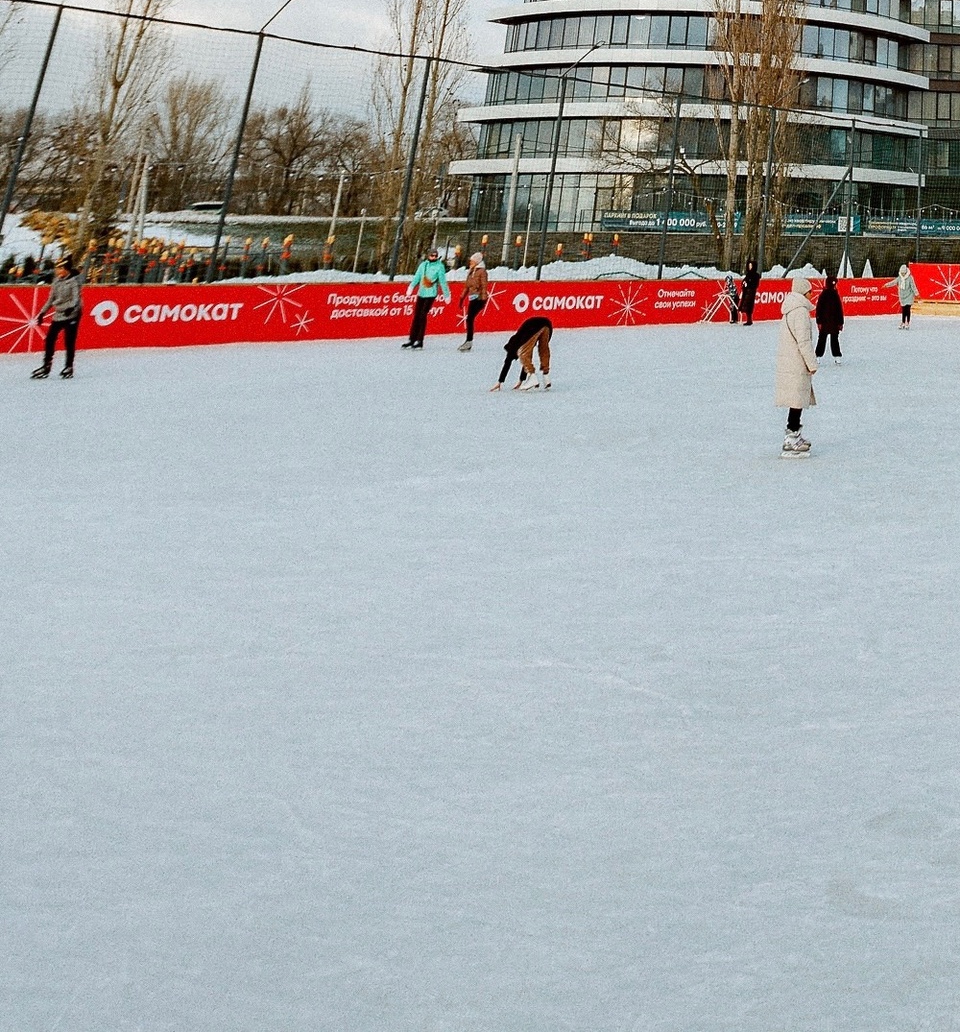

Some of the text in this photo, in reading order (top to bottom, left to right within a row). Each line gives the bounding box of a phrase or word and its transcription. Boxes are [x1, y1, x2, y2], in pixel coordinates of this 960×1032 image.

[657, 288, 696, 298] Отмечайте
[850, 285, 869, 295] Потому
[327, 293, 381, 307] Продукты
[383, 295, 390, 304] с
[532, 294, 604, 310] самокат
[654, 299, 697, 311] свои успехи
[123, 302, 244, 324] самокат
[330, 305, 389, 320] доставкой
[389, 308, 403, 317] от
[403, 305, 413, 316] 15
